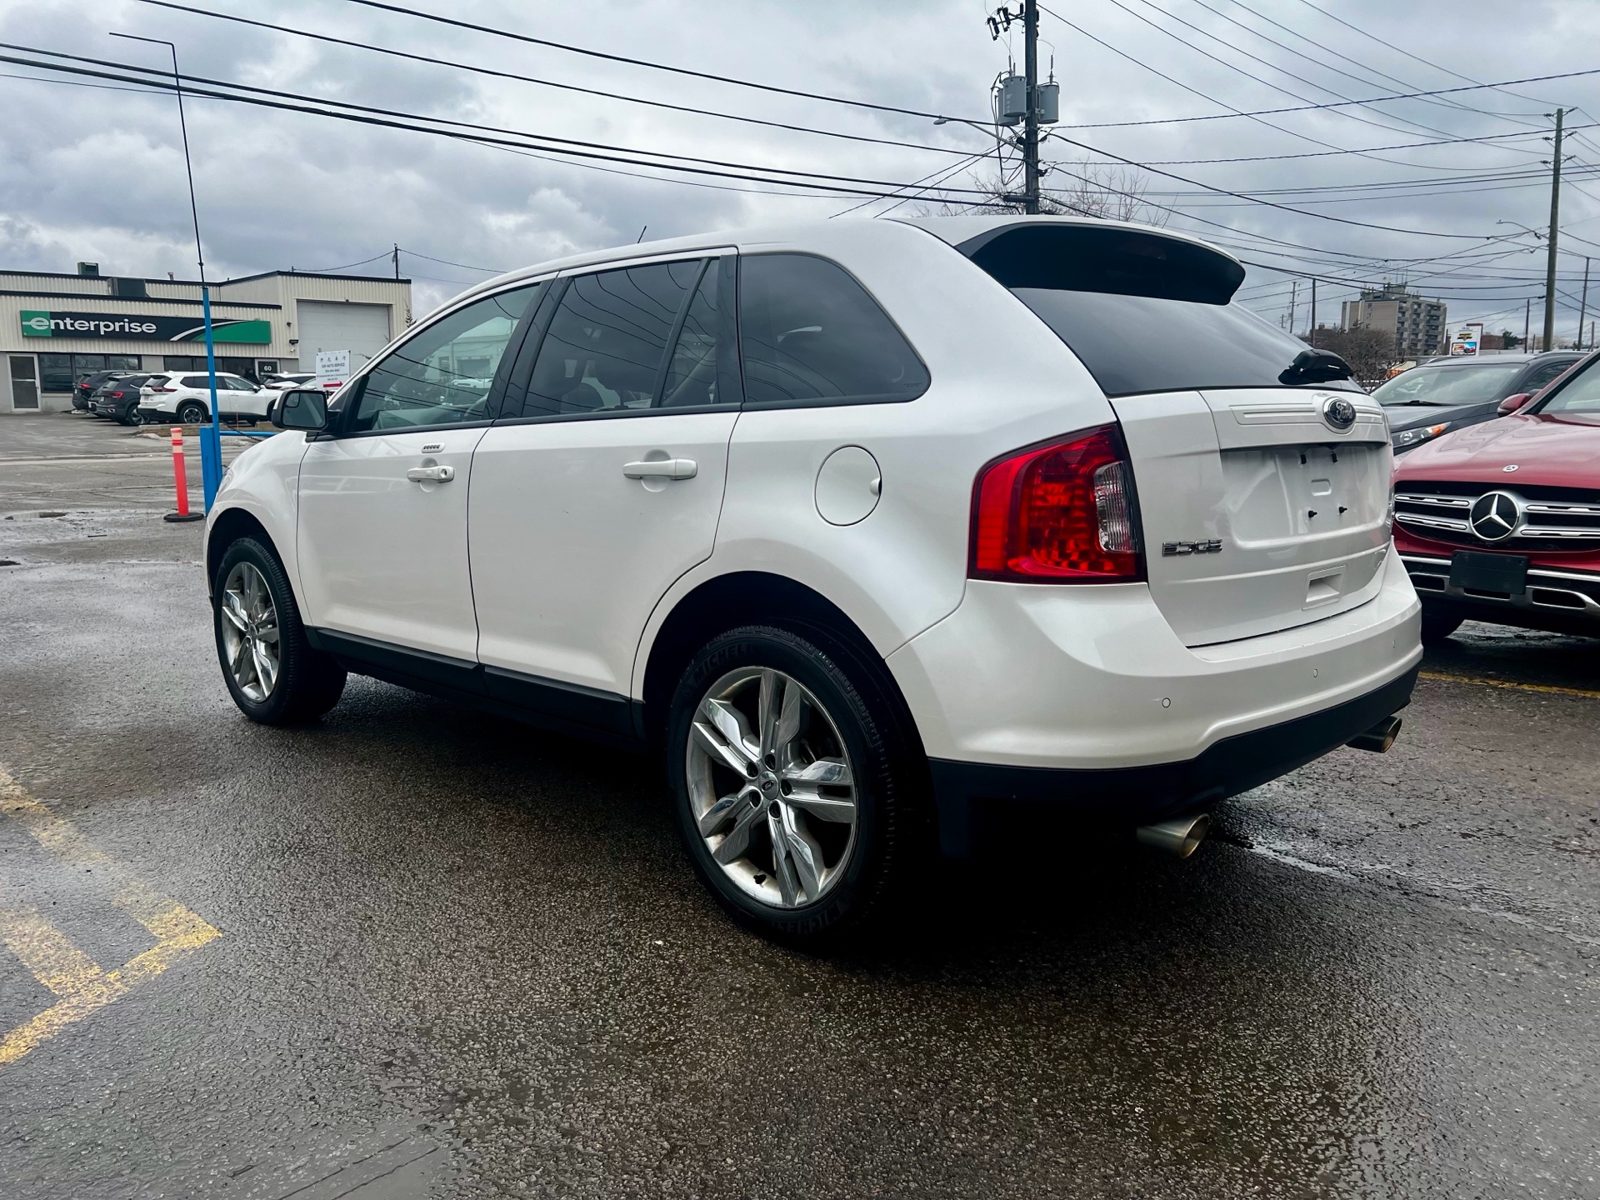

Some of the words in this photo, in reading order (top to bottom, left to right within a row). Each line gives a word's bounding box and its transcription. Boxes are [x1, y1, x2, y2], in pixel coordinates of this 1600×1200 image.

[30, 316, 157, 335] enterprise
[1162, 539, 1223, 557] EDGE
[693, 643, 756, 687] MICHELI
